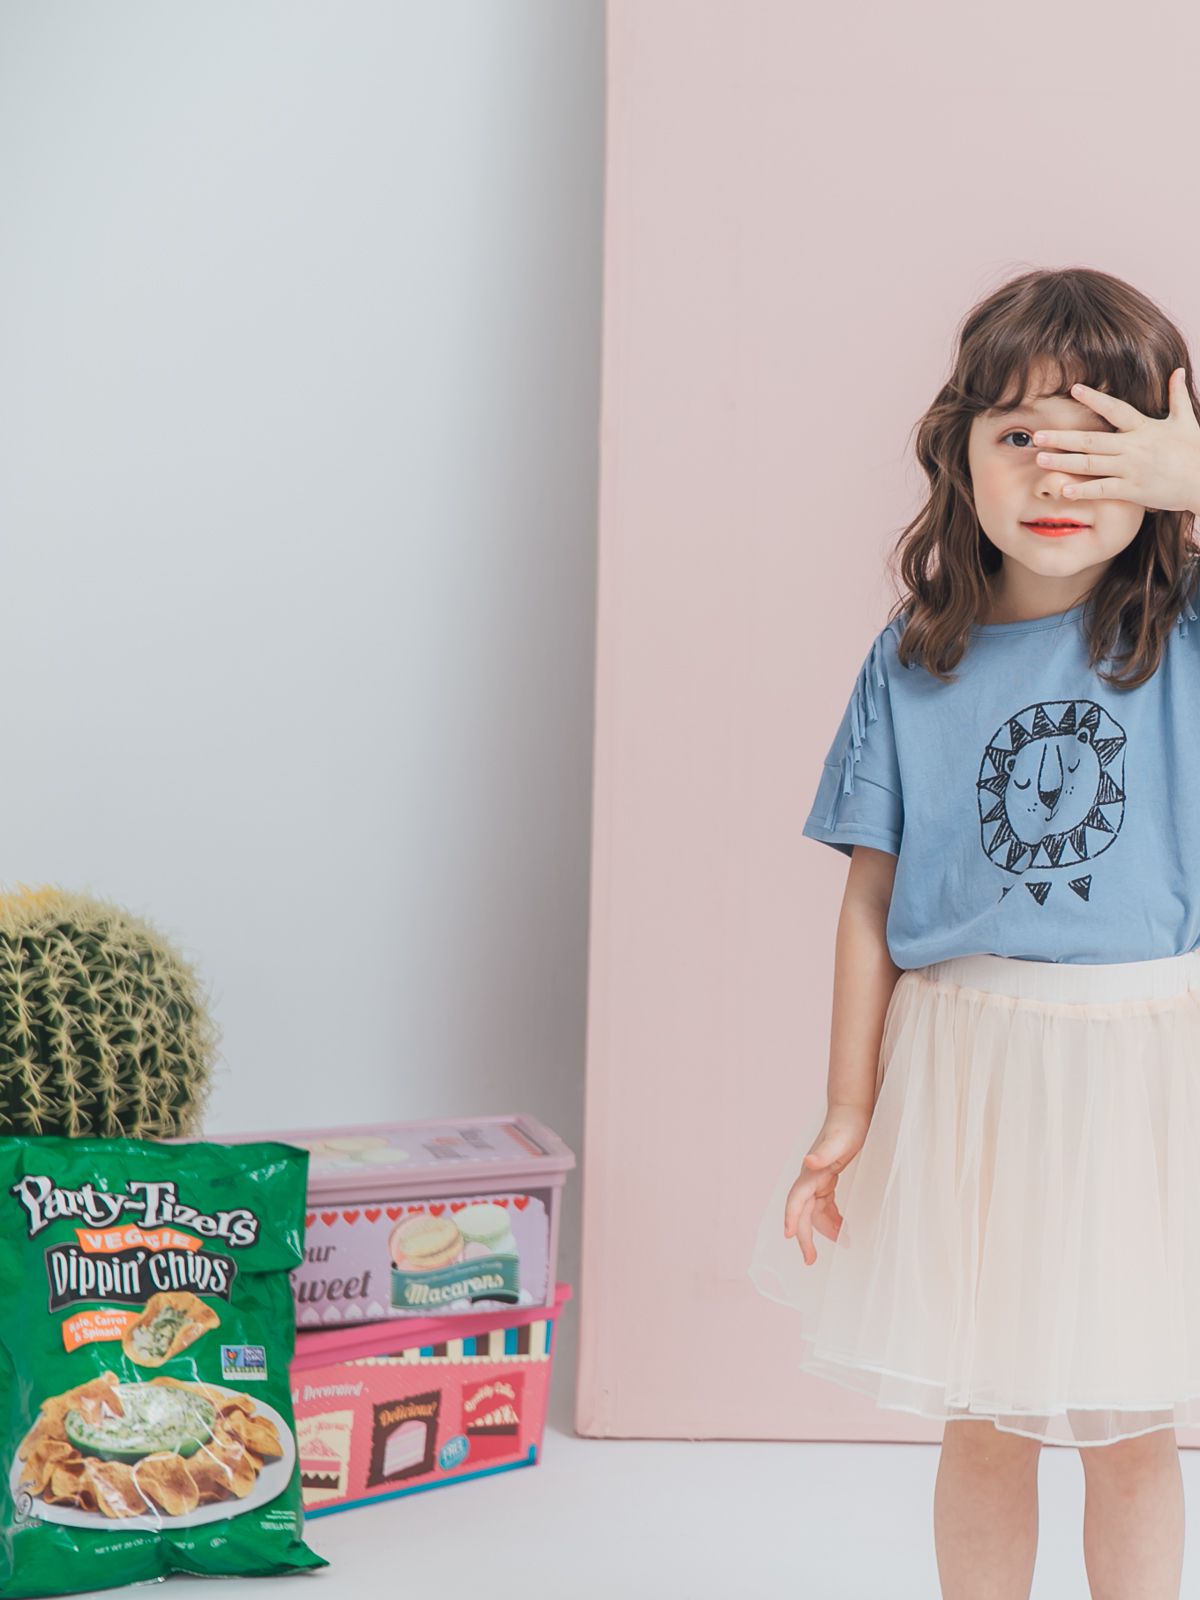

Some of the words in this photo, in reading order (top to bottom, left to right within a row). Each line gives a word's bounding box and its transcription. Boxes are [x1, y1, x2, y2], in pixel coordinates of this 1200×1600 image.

[11, 1174, 260, 1248] Party-Tizers
[85, 1228, 193, 1250] VEGGIE
[51, 1248, 147, 1297] Dippin'
[149, 1249, 229, 1294] Chips
[404, 1272, 505, 1306] Macarons
[82, 1326, 122, 1340] Spinach
